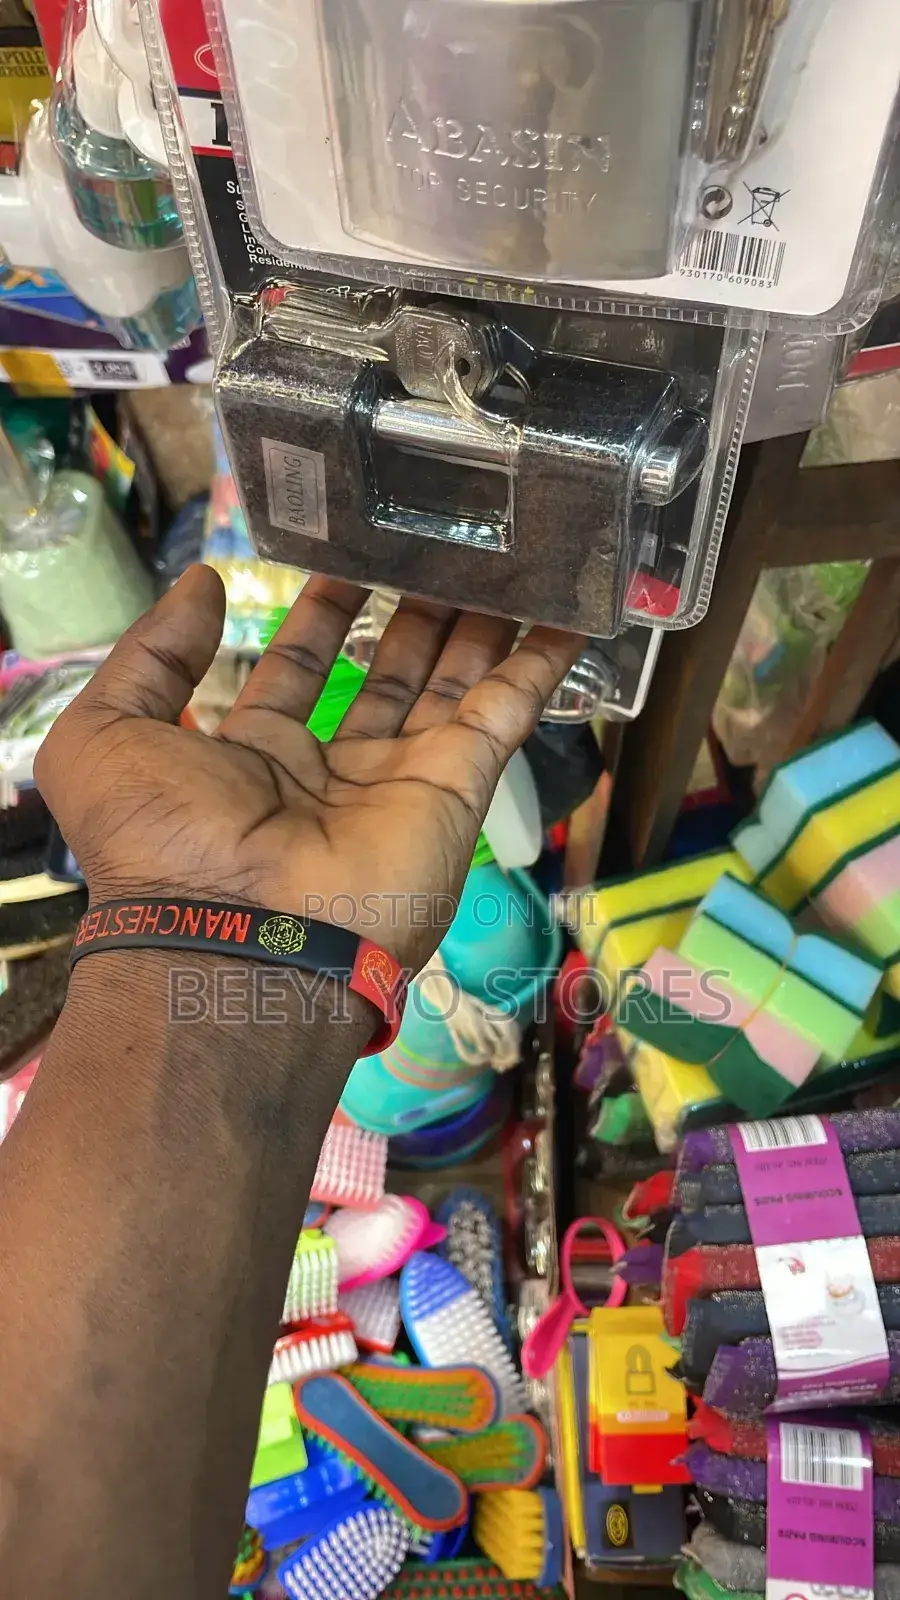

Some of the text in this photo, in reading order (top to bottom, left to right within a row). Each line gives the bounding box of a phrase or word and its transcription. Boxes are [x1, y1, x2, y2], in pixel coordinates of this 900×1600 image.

[386, 97, 611, 173] ABASIN
[396, 161, 442, 191] TOP
[456, 177, 598, 213] SECURITY
[283, 455, 306, 526] BAOLING
[75, 905, 252, 947] MANCHESTER
